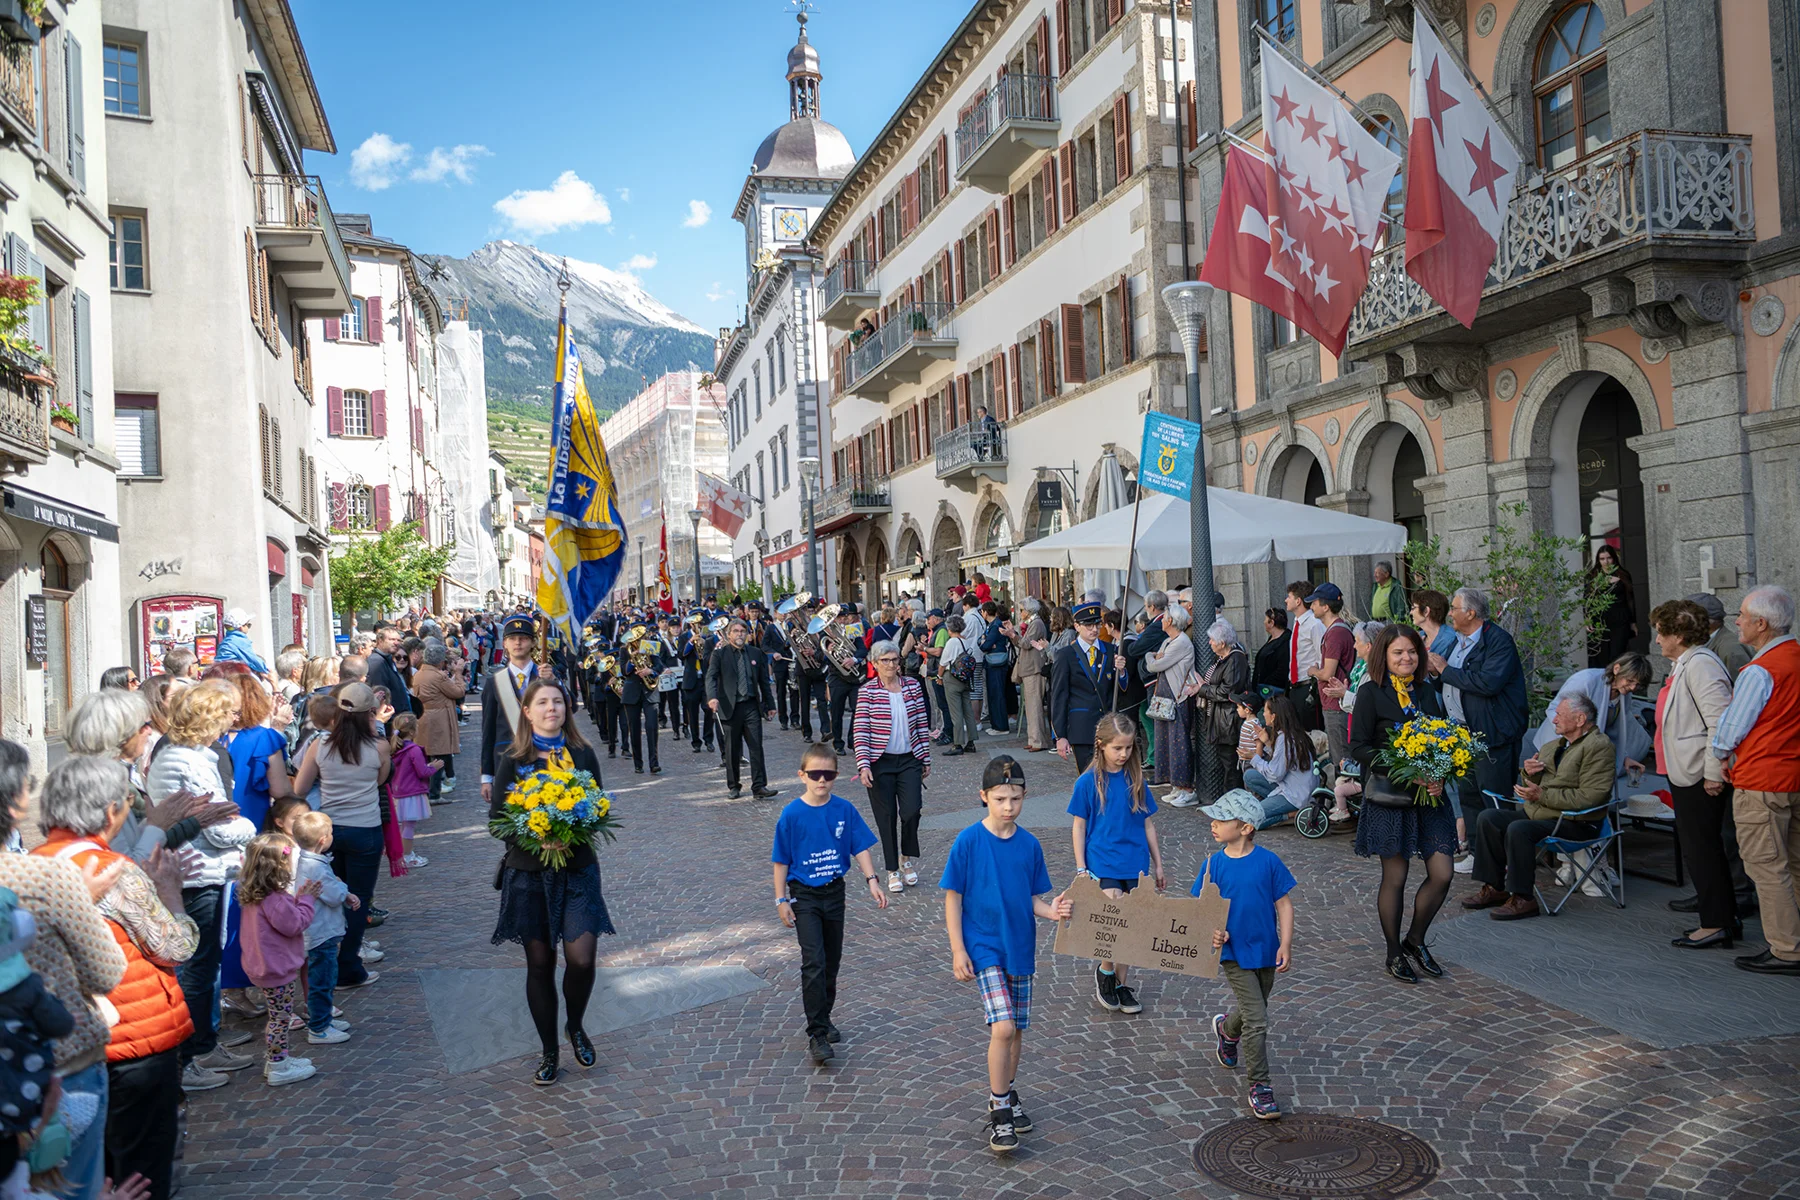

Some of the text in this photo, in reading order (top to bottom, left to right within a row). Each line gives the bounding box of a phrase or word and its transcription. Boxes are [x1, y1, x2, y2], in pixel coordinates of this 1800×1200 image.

[551, 483, 566, 504] La
[1102, 903, 1121, 915] 132e
[1089, 913, 1129, 929] FESTIVAL
[1169, 918, 1188, 935] La
[1095, 931, 1118, 943] SION
[1093, 947, 1113, 959] 2025
[1151, 937, 1198, 958] Liberté
[1160, 958, 1185, 970] Salins
